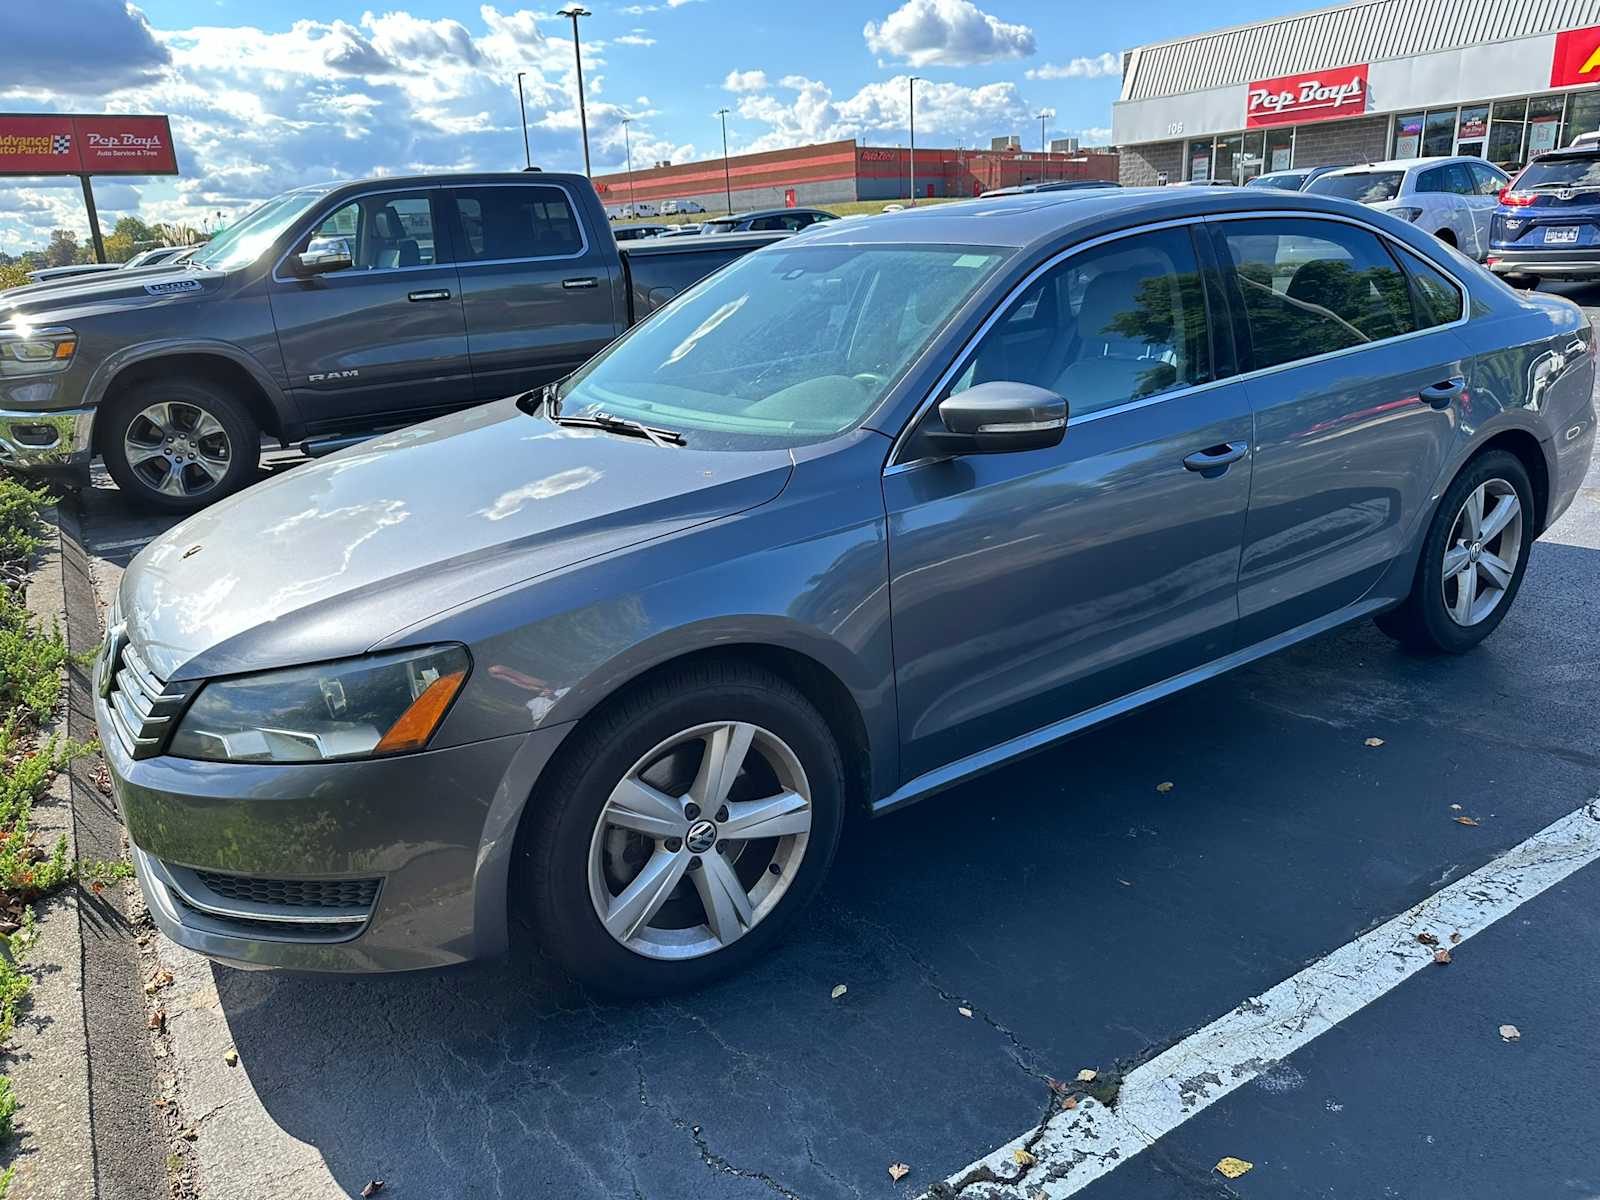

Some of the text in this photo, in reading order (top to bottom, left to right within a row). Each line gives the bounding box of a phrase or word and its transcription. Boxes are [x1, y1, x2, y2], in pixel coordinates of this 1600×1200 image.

[1249, 76, 1362, 112] Pep Boys
[87, 133, 160, 149] Pep Boys
[17, 145, 49, 154] Parts
[308, 370, 359, 382] RAM
